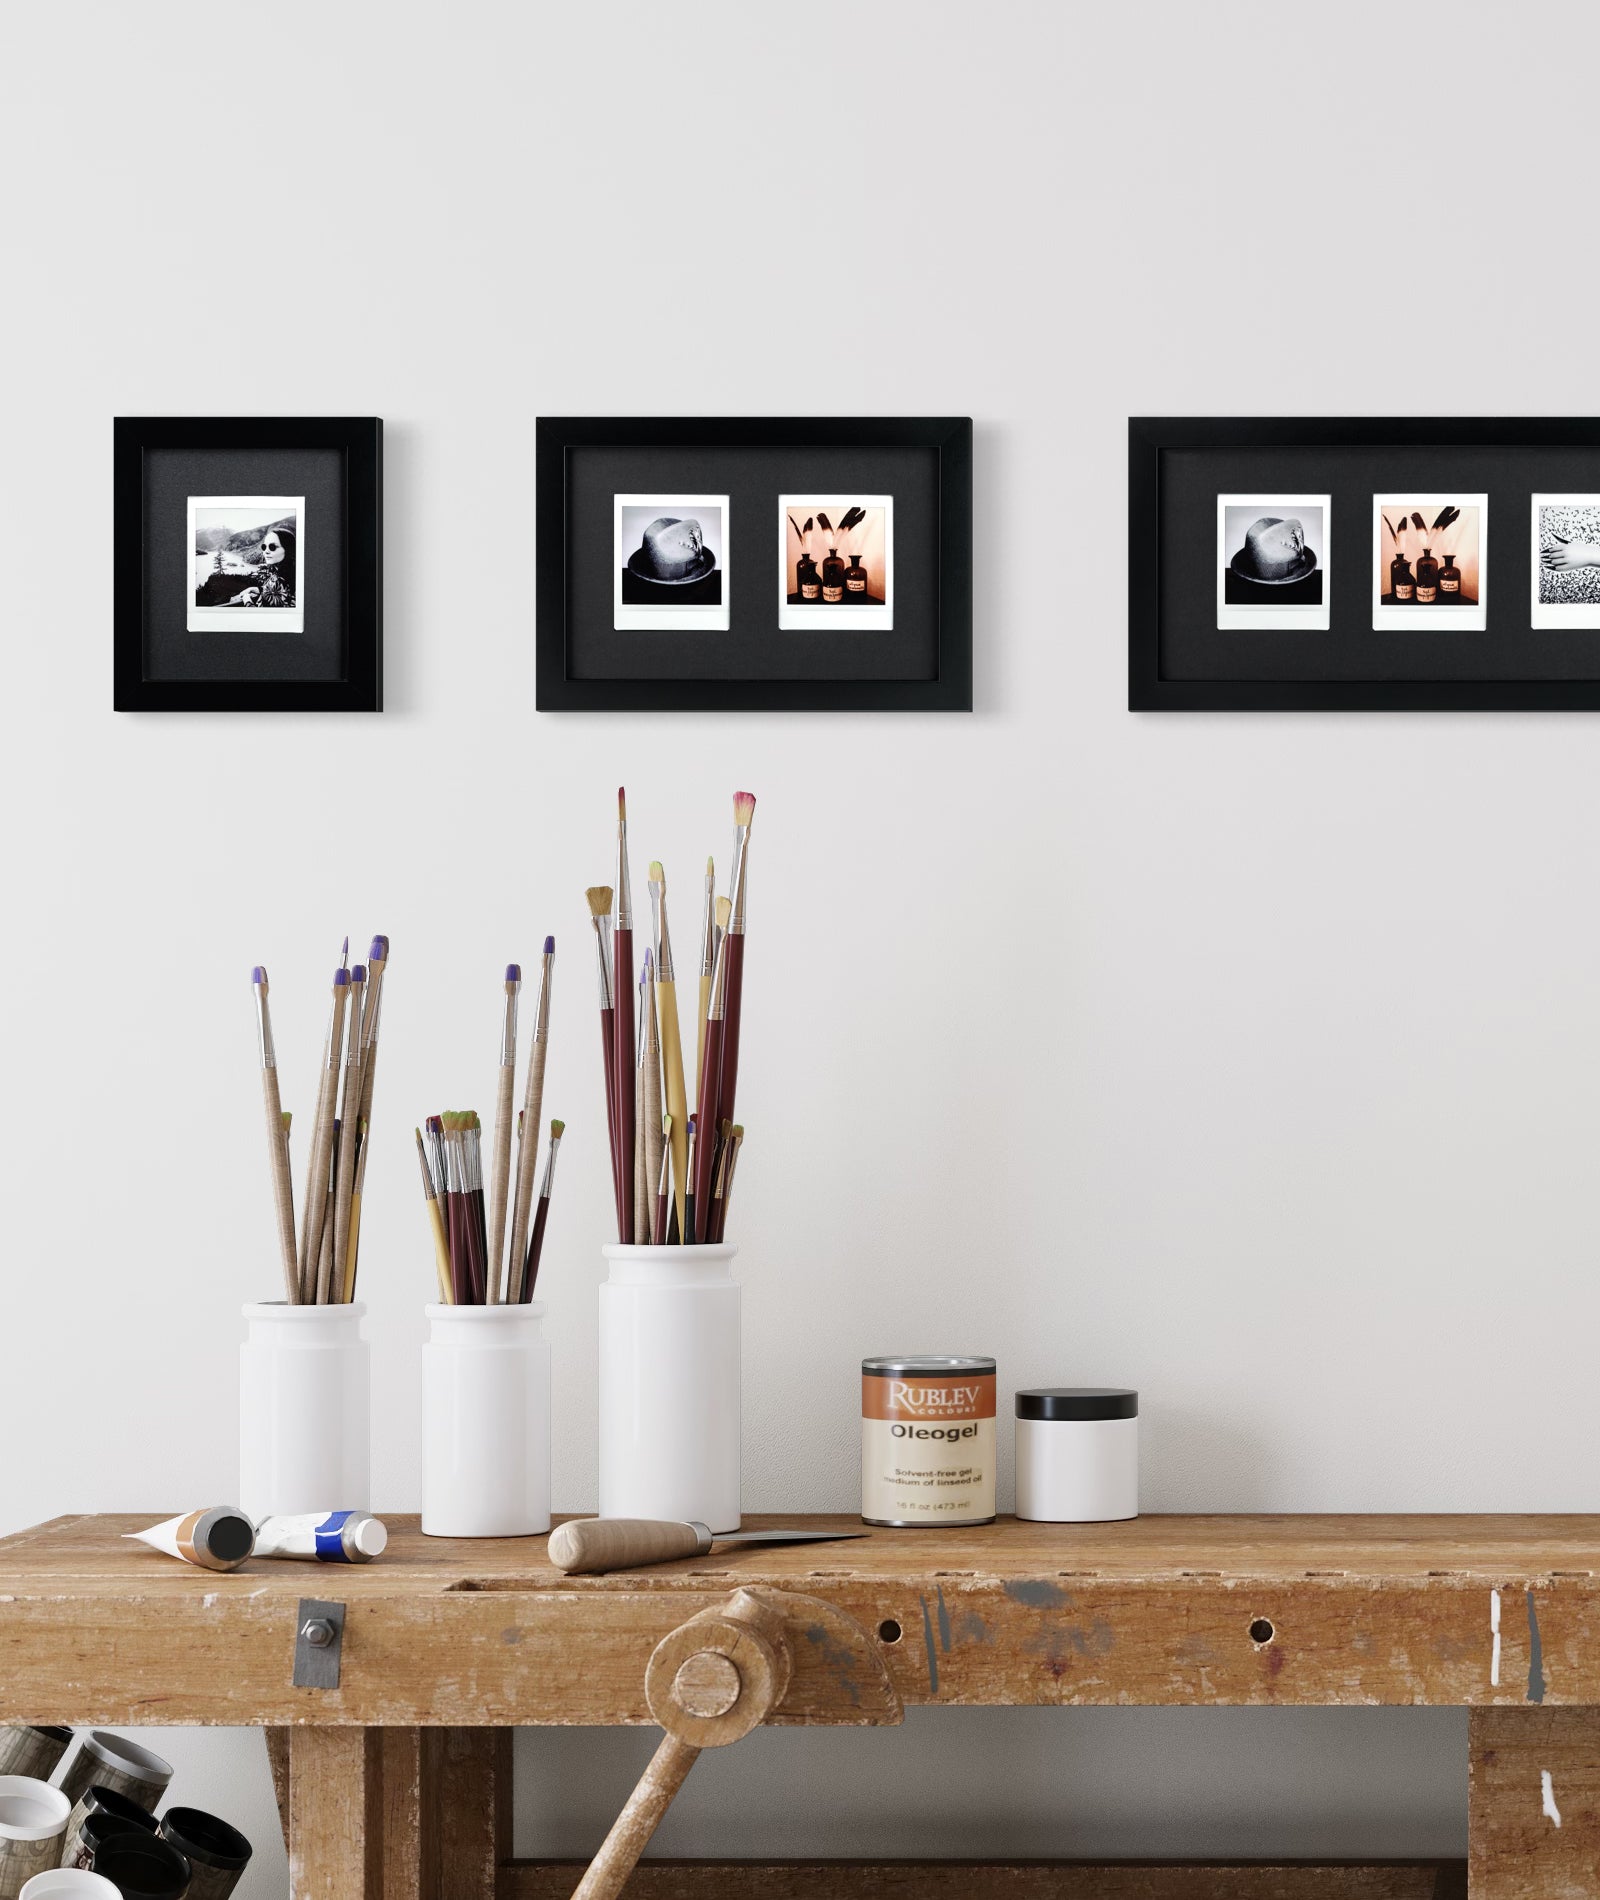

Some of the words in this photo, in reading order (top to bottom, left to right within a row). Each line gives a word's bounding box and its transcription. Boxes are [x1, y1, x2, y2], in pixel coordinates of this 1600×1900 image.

[887, 1380, 981, 1415] RUBLEV
[891, 1423, 978, 1443] Oleogel
[895, 1468, 957, 1478] Solvent-free
[959, 1468, 973, 1477] gel
[883, 1476, 920, 1486] medium
[923, 1479, 935, 1487] of
[937, 1477, 971, 1486] linseed
[973, 1474, 982, 1483] oil
[918, 1503, 930, 1511] oz
